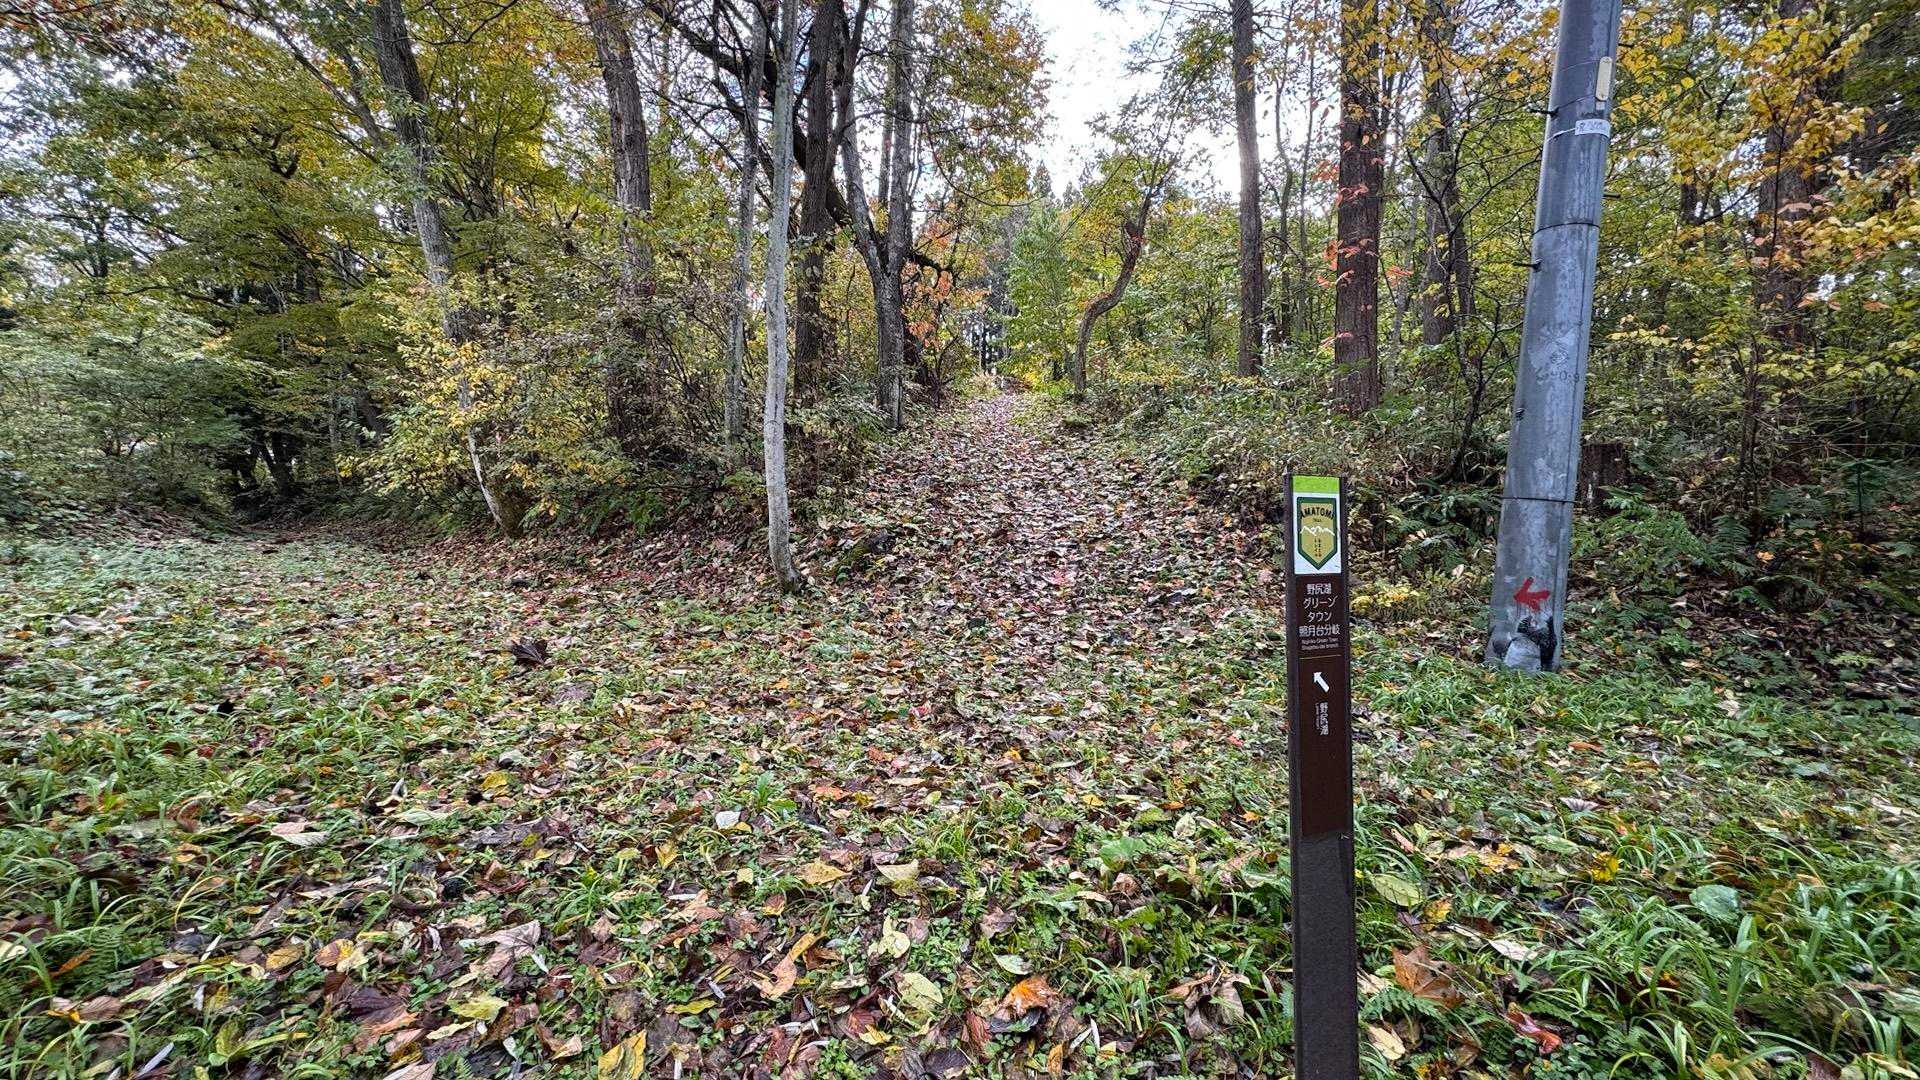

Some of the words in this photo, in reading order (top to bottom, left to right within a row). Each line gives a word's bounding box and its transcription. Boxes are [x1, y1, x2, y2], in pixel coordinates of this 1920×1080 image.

[1307, 583, 1332, 595] 野尻湖
[1303, 596, 1338, 609] グリーン
[1308, 611, 1332, 623] タウン
[1299, 624, 1341, 637] 照月台分岐
[1319, 702, 1329, 736] 野尻湖
